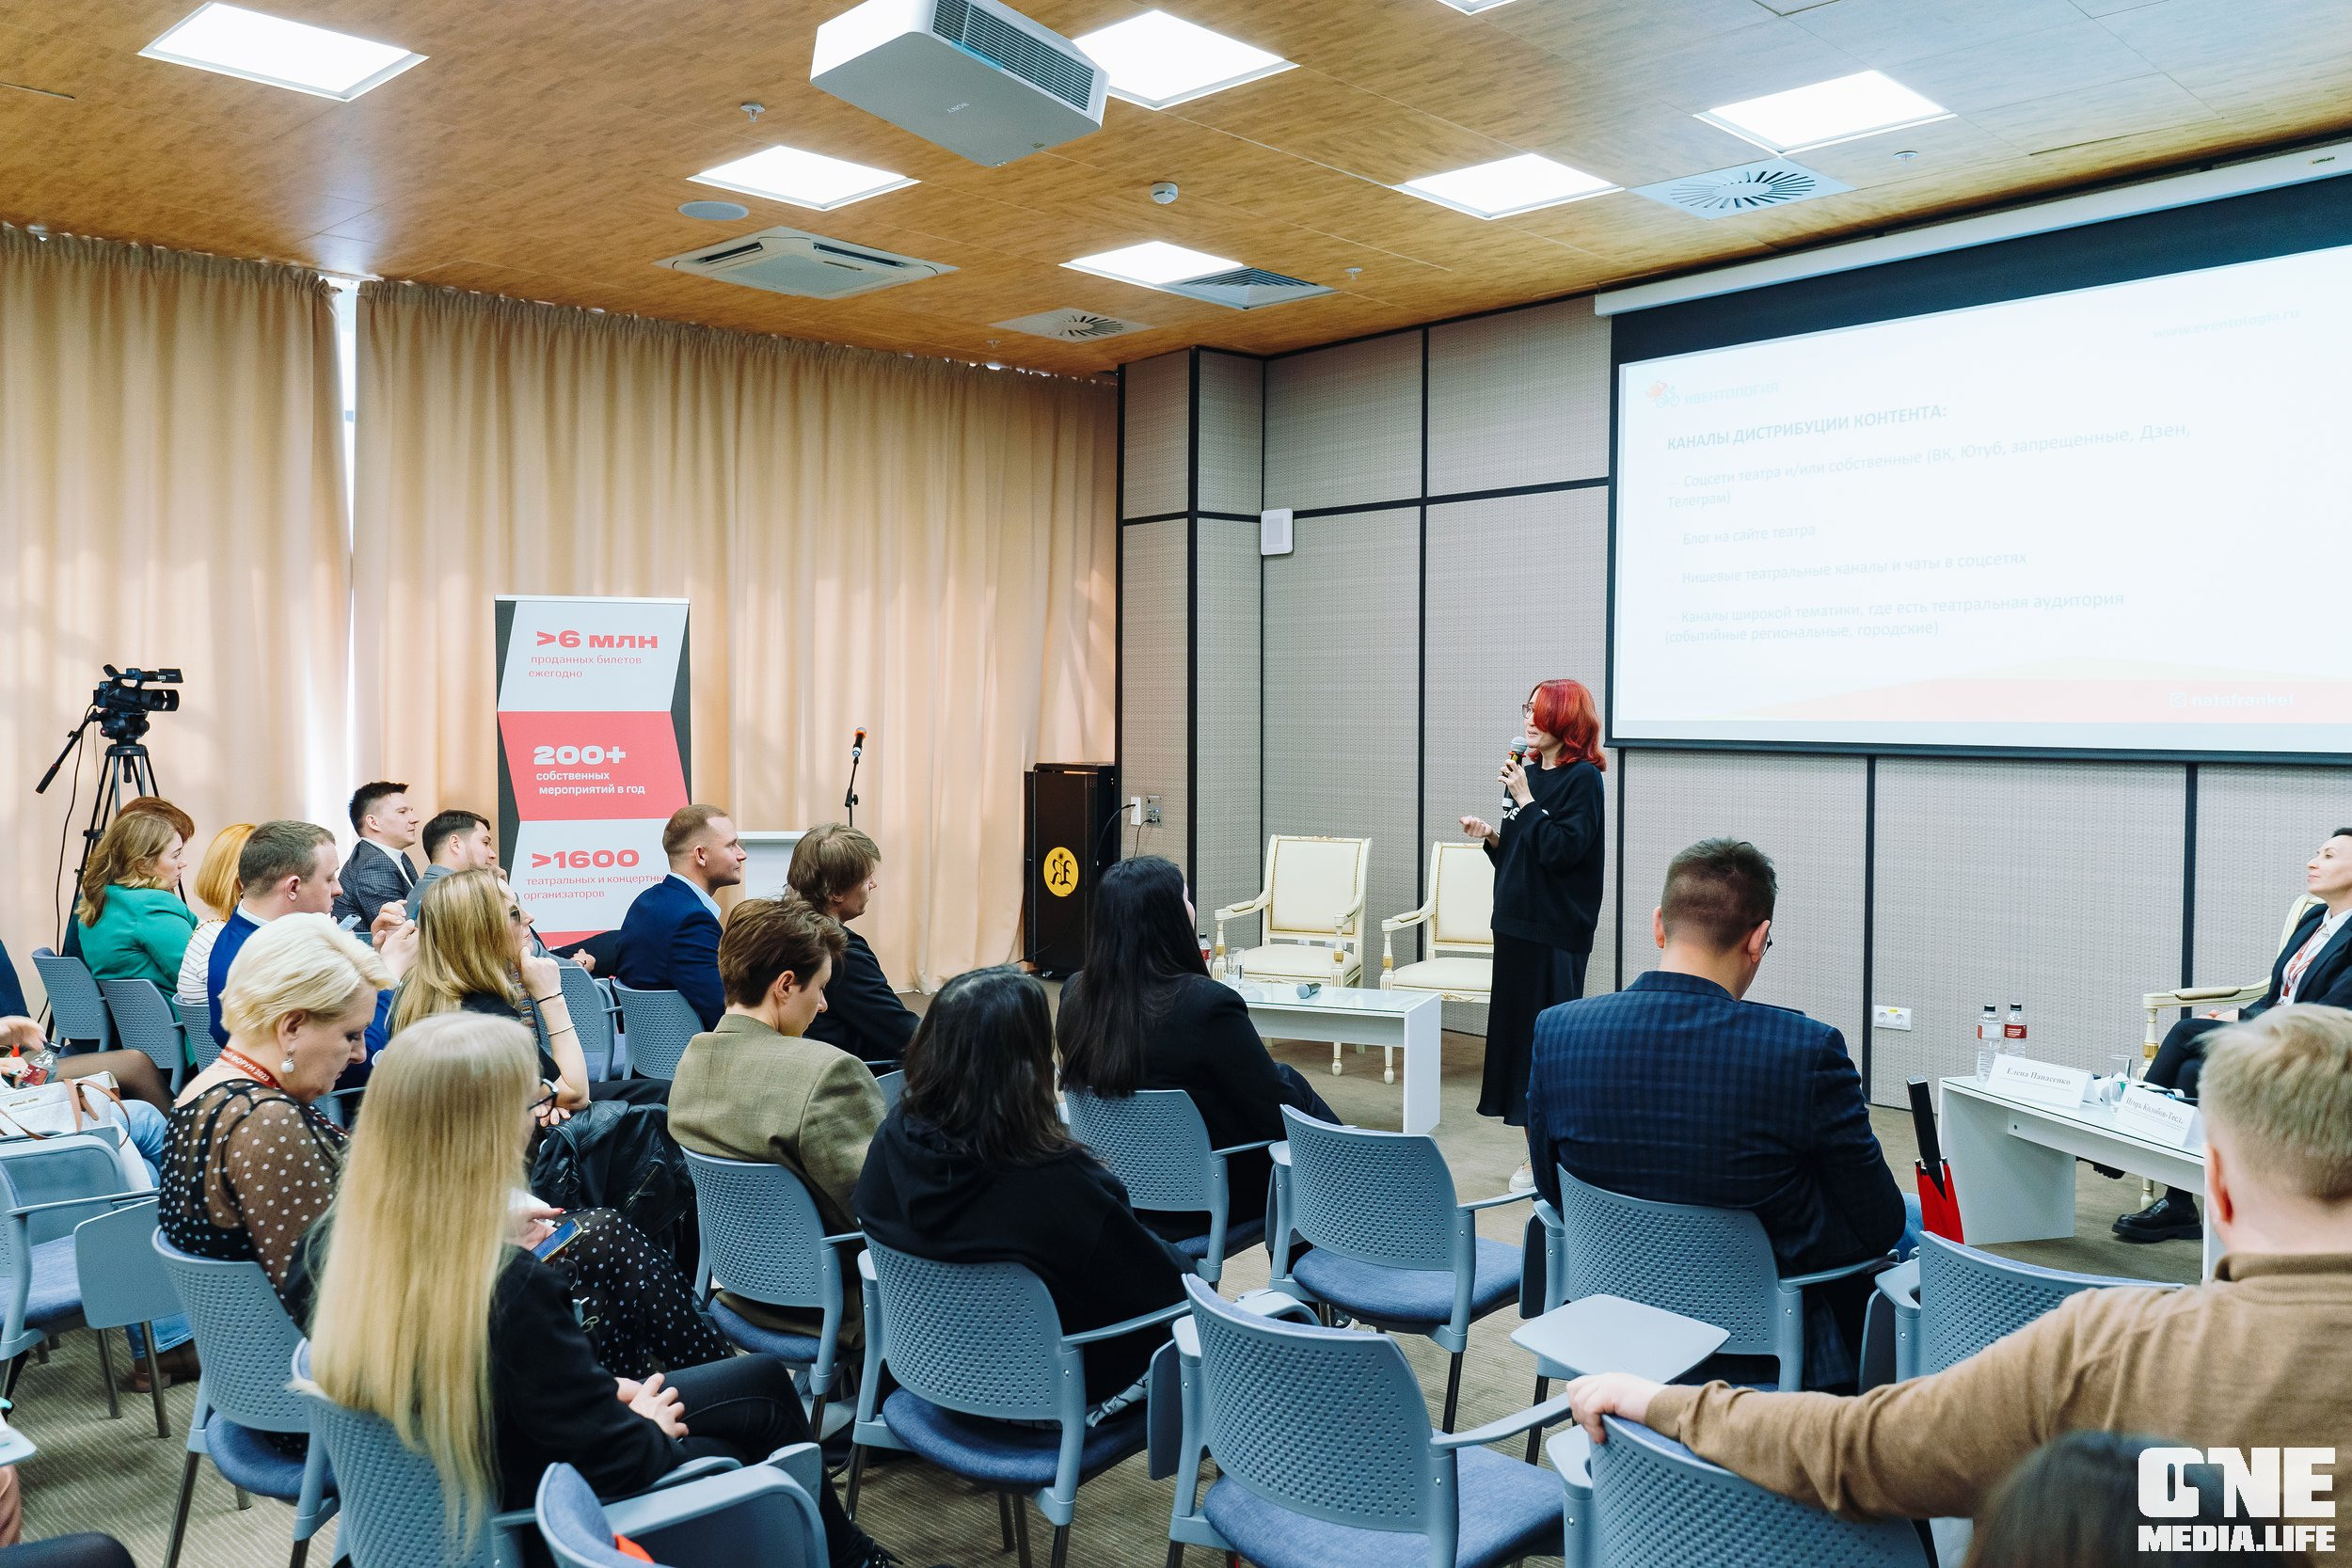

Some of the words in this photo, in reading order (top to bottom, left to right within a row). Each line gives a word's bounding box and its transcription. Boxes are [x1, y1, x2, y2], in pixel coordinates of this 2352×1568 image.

[1684, 382, 1779, 405] ИВЕНТОЛОГИЯ
[1667, 434, 1729, 451] КАНАЛЫ
[1732, 416, 1850, 445] ДИСТРИБУЦИИ
[1853, 404, 1947, 428] КОНТЕНТА:
[1684, 473, 1735, 488] Соцсети
[1739, 467, 1781, 483] театра
[1785, 462, 1825, 478] и/или
[1828, 451, 1922, 473] собственные
[1927, 447, 1956, 466] (ВК,
[1961, 440, 2006, 458] Ютуб,
[2010, 428, 2134, 458] запрещенные,
[2139, 423, 2191, 442] Дзен,
[1666, 490, 1731, 510] Телеграм)
[1683, 531, 1711, 546] Блог
[1714, 533, 1729, 544] на
[1732, 528, 1769, 542] сайте
[1772, 525, 1816, 540] театра
[1682, 571, 1740, 584] Нишевые
[1745, 564, 1830, 581] театральные
[1836, 560, 1887, 575] каналы
[1892, 561, 1901, 572] и
[1905, 558, 1941, 571] чаты
[1945, 556, 1955, 568] в
[1958, 551, 2027, 570] соцсетях
[1681, 610, 1728, 624] Каналы
[1732, 605, 1791, 623] широкой
[1795, 605, 1864, 620] тематики,
[1868, 603, 1892, 616] где
[1897, 601, 1928, 614] есть
[1931, 597, 2027, 614] театральная
[2033, 593, 2124, 610] аудитория
[536, 629, 580, 648] >6
[589, 634, 658, 649] млн
[1665, 629, 1747, 645] (событийные
[1751, 624, 1852, 643] региональные,
[1857, 620, 1939, 641] городские)
[531, 655, 594, 666] проданных
[596, 654, 642, 664] билетов
[529, 669, 583, 679] ежегодно
[533, 745, 626, 766] 200+
[536, 770, 610, 781] собственных
[539, 784, 615, 797] мероприятий
[626, 785, 645, 796] год
[532, 848, 640, 869] >1600
[527, 875, 596, 885] театральных
[597, 875, 605, 883] и
[524, 889, 605, 900] организаторов
[2007, 1067, 2029, 1078] Елена
